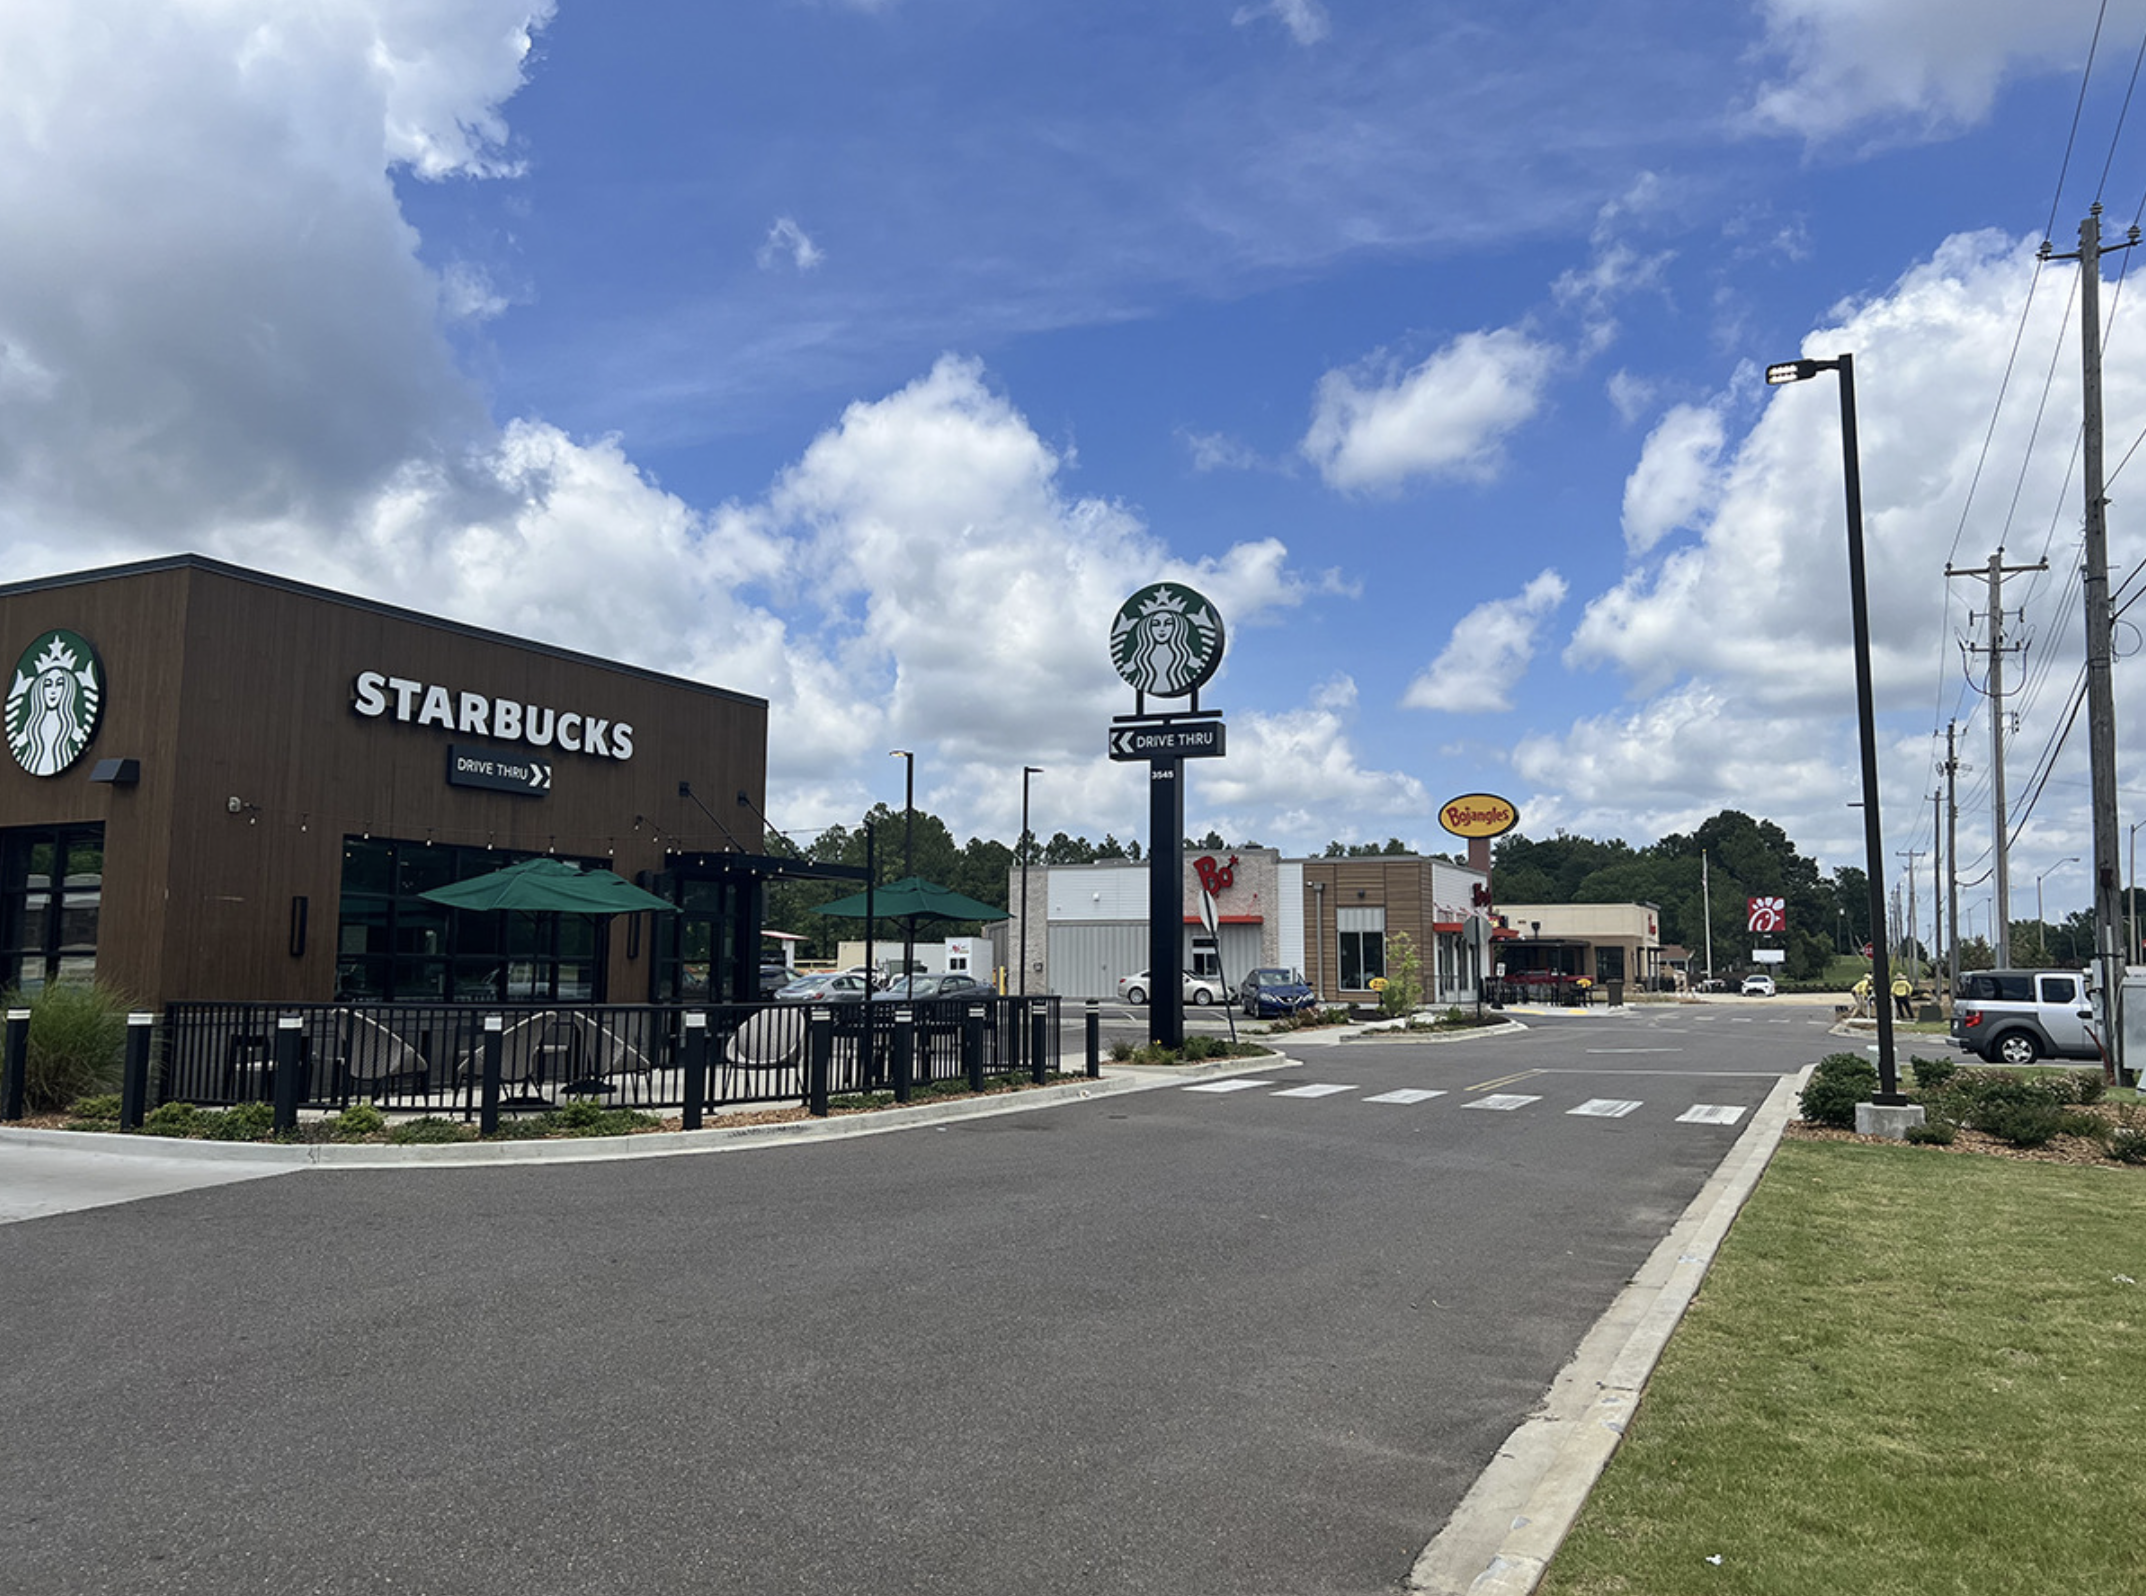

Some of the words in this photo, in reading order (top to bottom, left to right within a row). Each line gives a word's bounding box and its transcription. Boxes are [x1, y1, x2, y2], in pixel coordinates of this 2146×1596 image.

[354, 670, 634, 761] STARBUCKS
[1136, 733, 1175, 749] DRIVE
[1178, 731, 1213, 746] THRU
[457, 757, 494, 775] DRIVE
[496, 763, 529, 780] THRU
